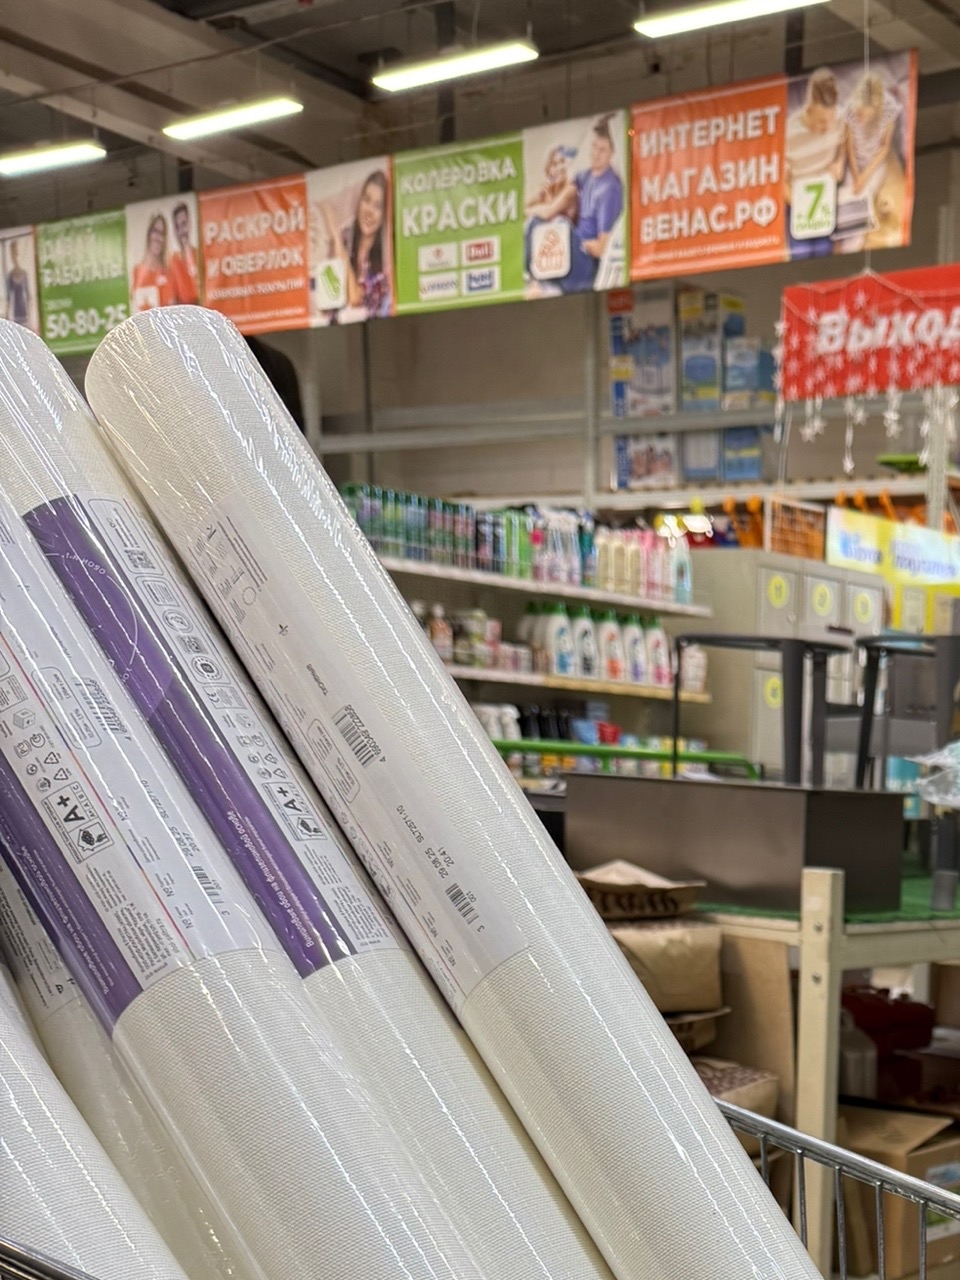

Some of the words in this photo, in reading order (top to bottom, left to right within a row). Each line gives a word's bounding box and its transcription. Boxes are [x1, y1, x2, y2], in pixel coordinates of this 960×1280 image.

[640, 105, 781, 158] ИНТЕРНЕТ
[400, 157, 517, 195] КОЛЕРОВКА
[641, 152, 780, 206] МАГАЗИН
[205, 199, 306, 246] РАСКРОЙ
[402, 189, 519, 237] КРАСКИ
[641, 195, 778, 245] ВЕНАС.РФ
[207, 257, 219, 279] И
[221, 246, 304, 277] ОВЕРЛОК
[342, 702, 365, 731] 222858
[360, 728, 382, 757] 690349
[378, 755, 387, 764] 4
[51, 790, 85, 829] A+
[278, 783, 304, 812] A+
[225, 808, 246, 835] основе
[395, 803, 425, 844] SL72571-10
[239, 831, 276, 884] флизелиновой
[436, 845, 454, 867] 20:41
[270, 880, 280, 891] на
[274, 888, 291, 910] обои
[285, 906, 315, 948] Виниловые
[475, 923, 486, 933] 3
